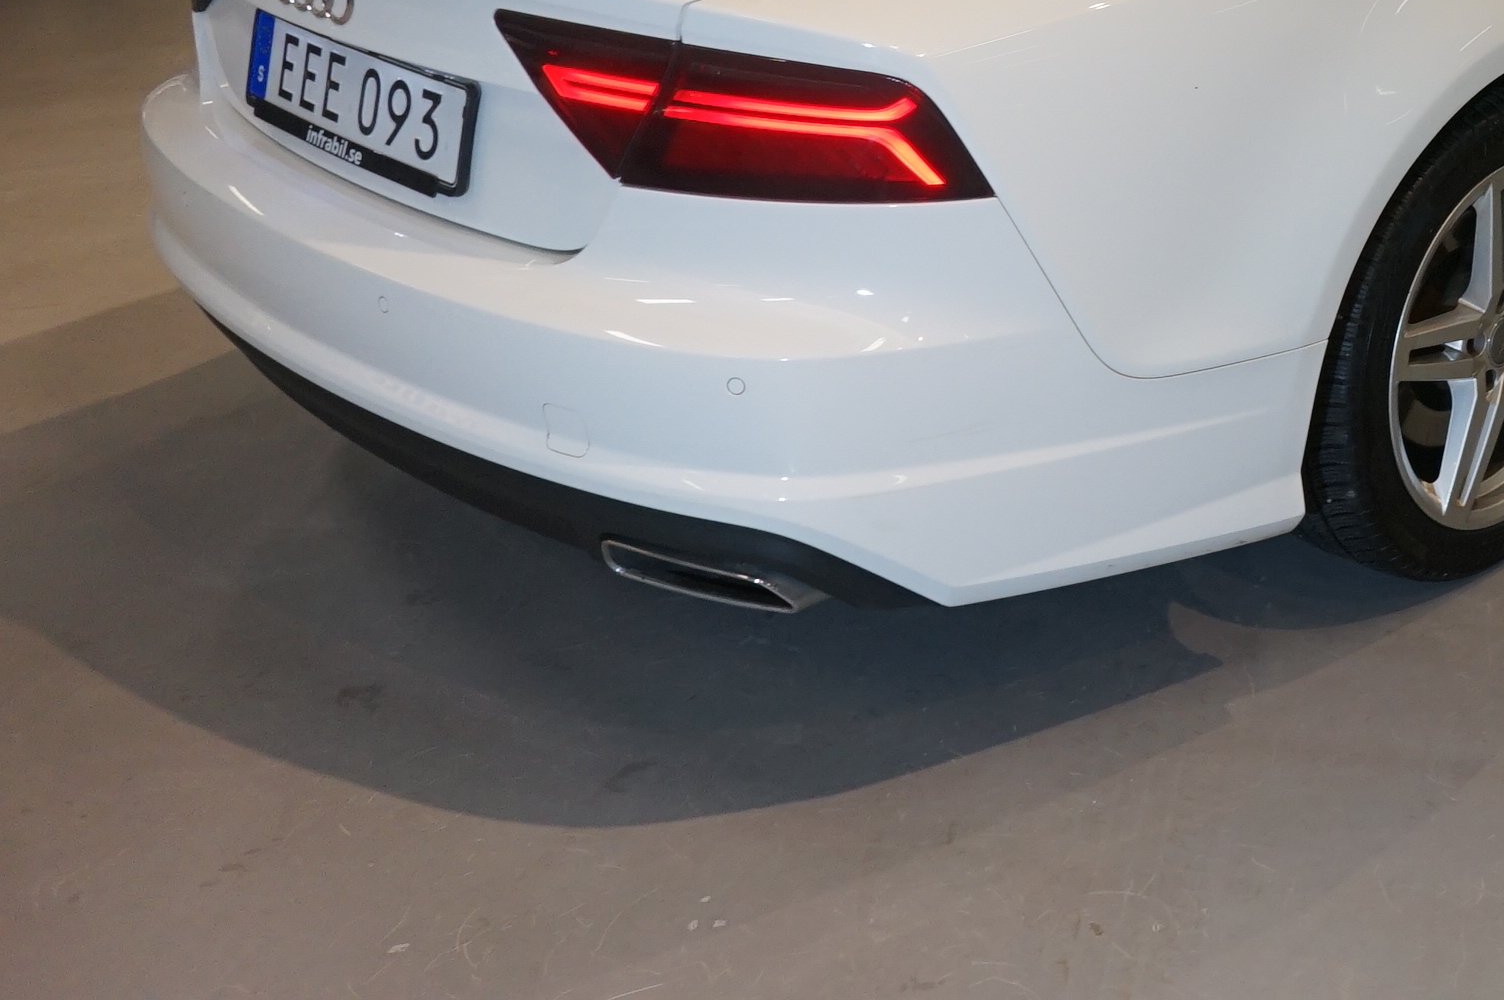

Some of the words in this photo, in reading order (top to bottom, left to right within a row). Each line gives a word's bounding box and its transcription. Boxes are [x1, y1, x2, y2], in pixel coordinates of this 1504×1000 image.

[256, 64, 265, 83] S
[278, 33, 347, 124] EEE
[357, 68, 443, 161] 093
[306, 125, 363, 166] infrabil.se
